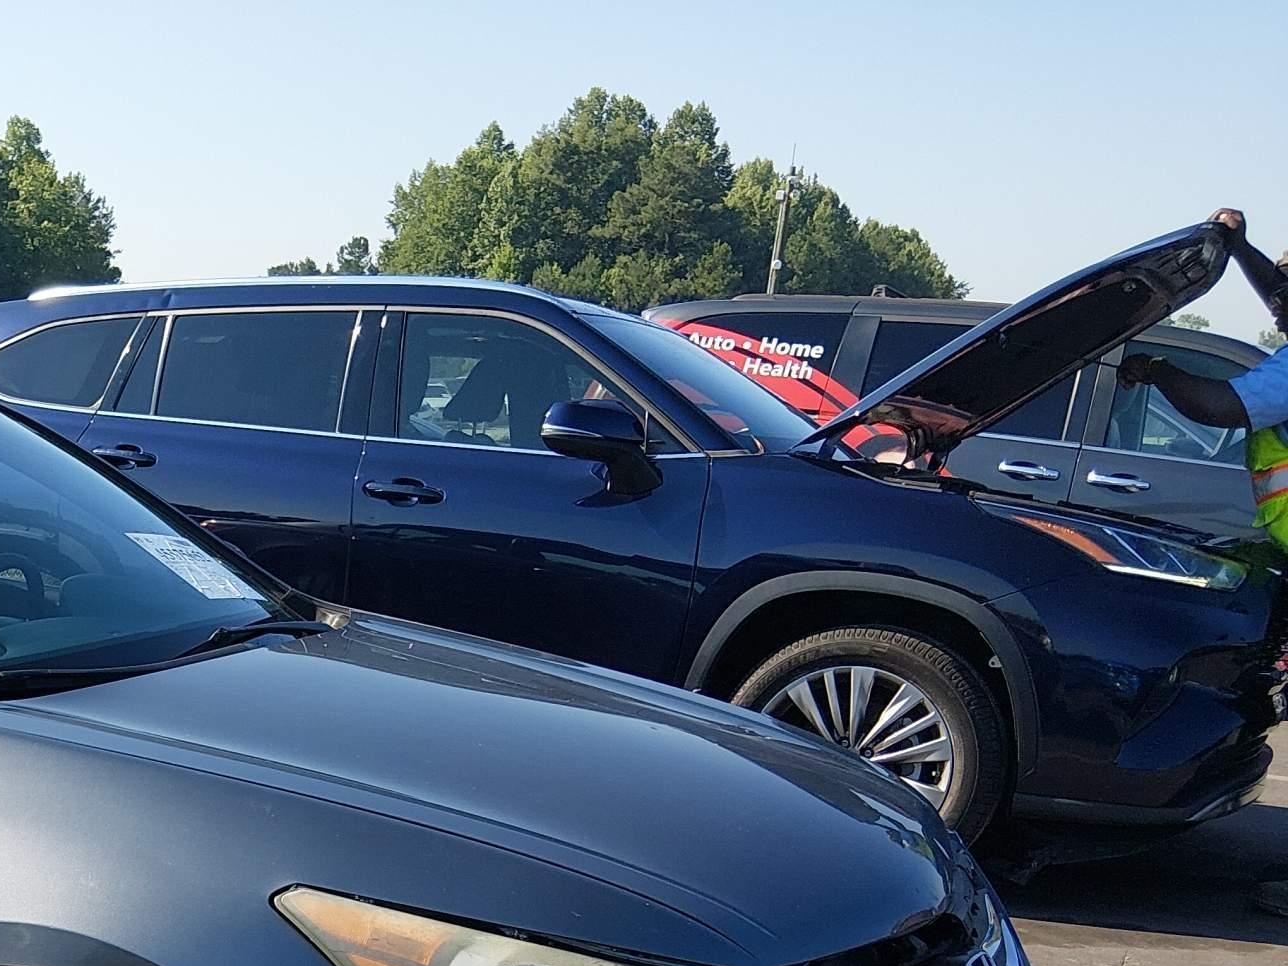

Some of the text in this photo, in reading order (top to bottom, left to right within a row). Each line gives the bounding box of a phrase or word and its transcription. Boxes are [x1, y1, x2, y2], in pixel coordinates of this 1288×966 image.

[688, 332, 824, 358] Auto Home
[742, 359, 813, 379] Health
